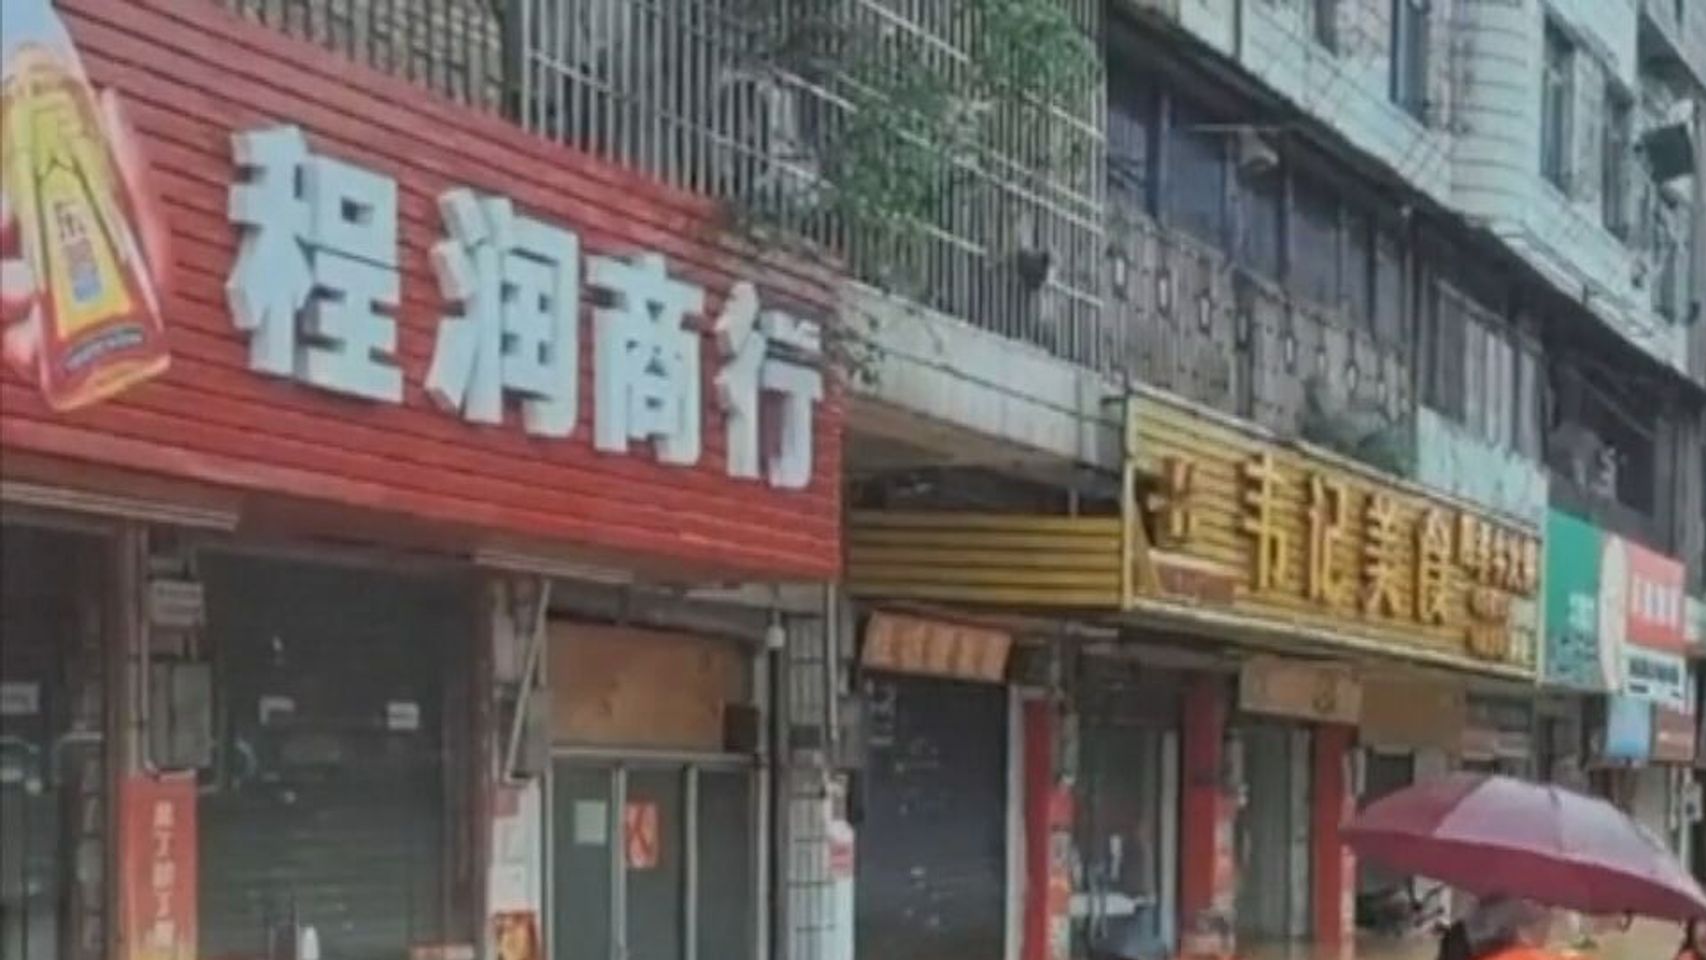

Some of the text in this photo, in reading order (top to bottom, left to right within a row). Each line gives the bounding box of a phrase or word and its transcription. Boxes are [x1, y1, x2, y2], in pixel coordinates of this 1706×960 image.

[225, 124, 824, 488] 程润商行
[1244, 451, 1450, 627] 韦记美食
